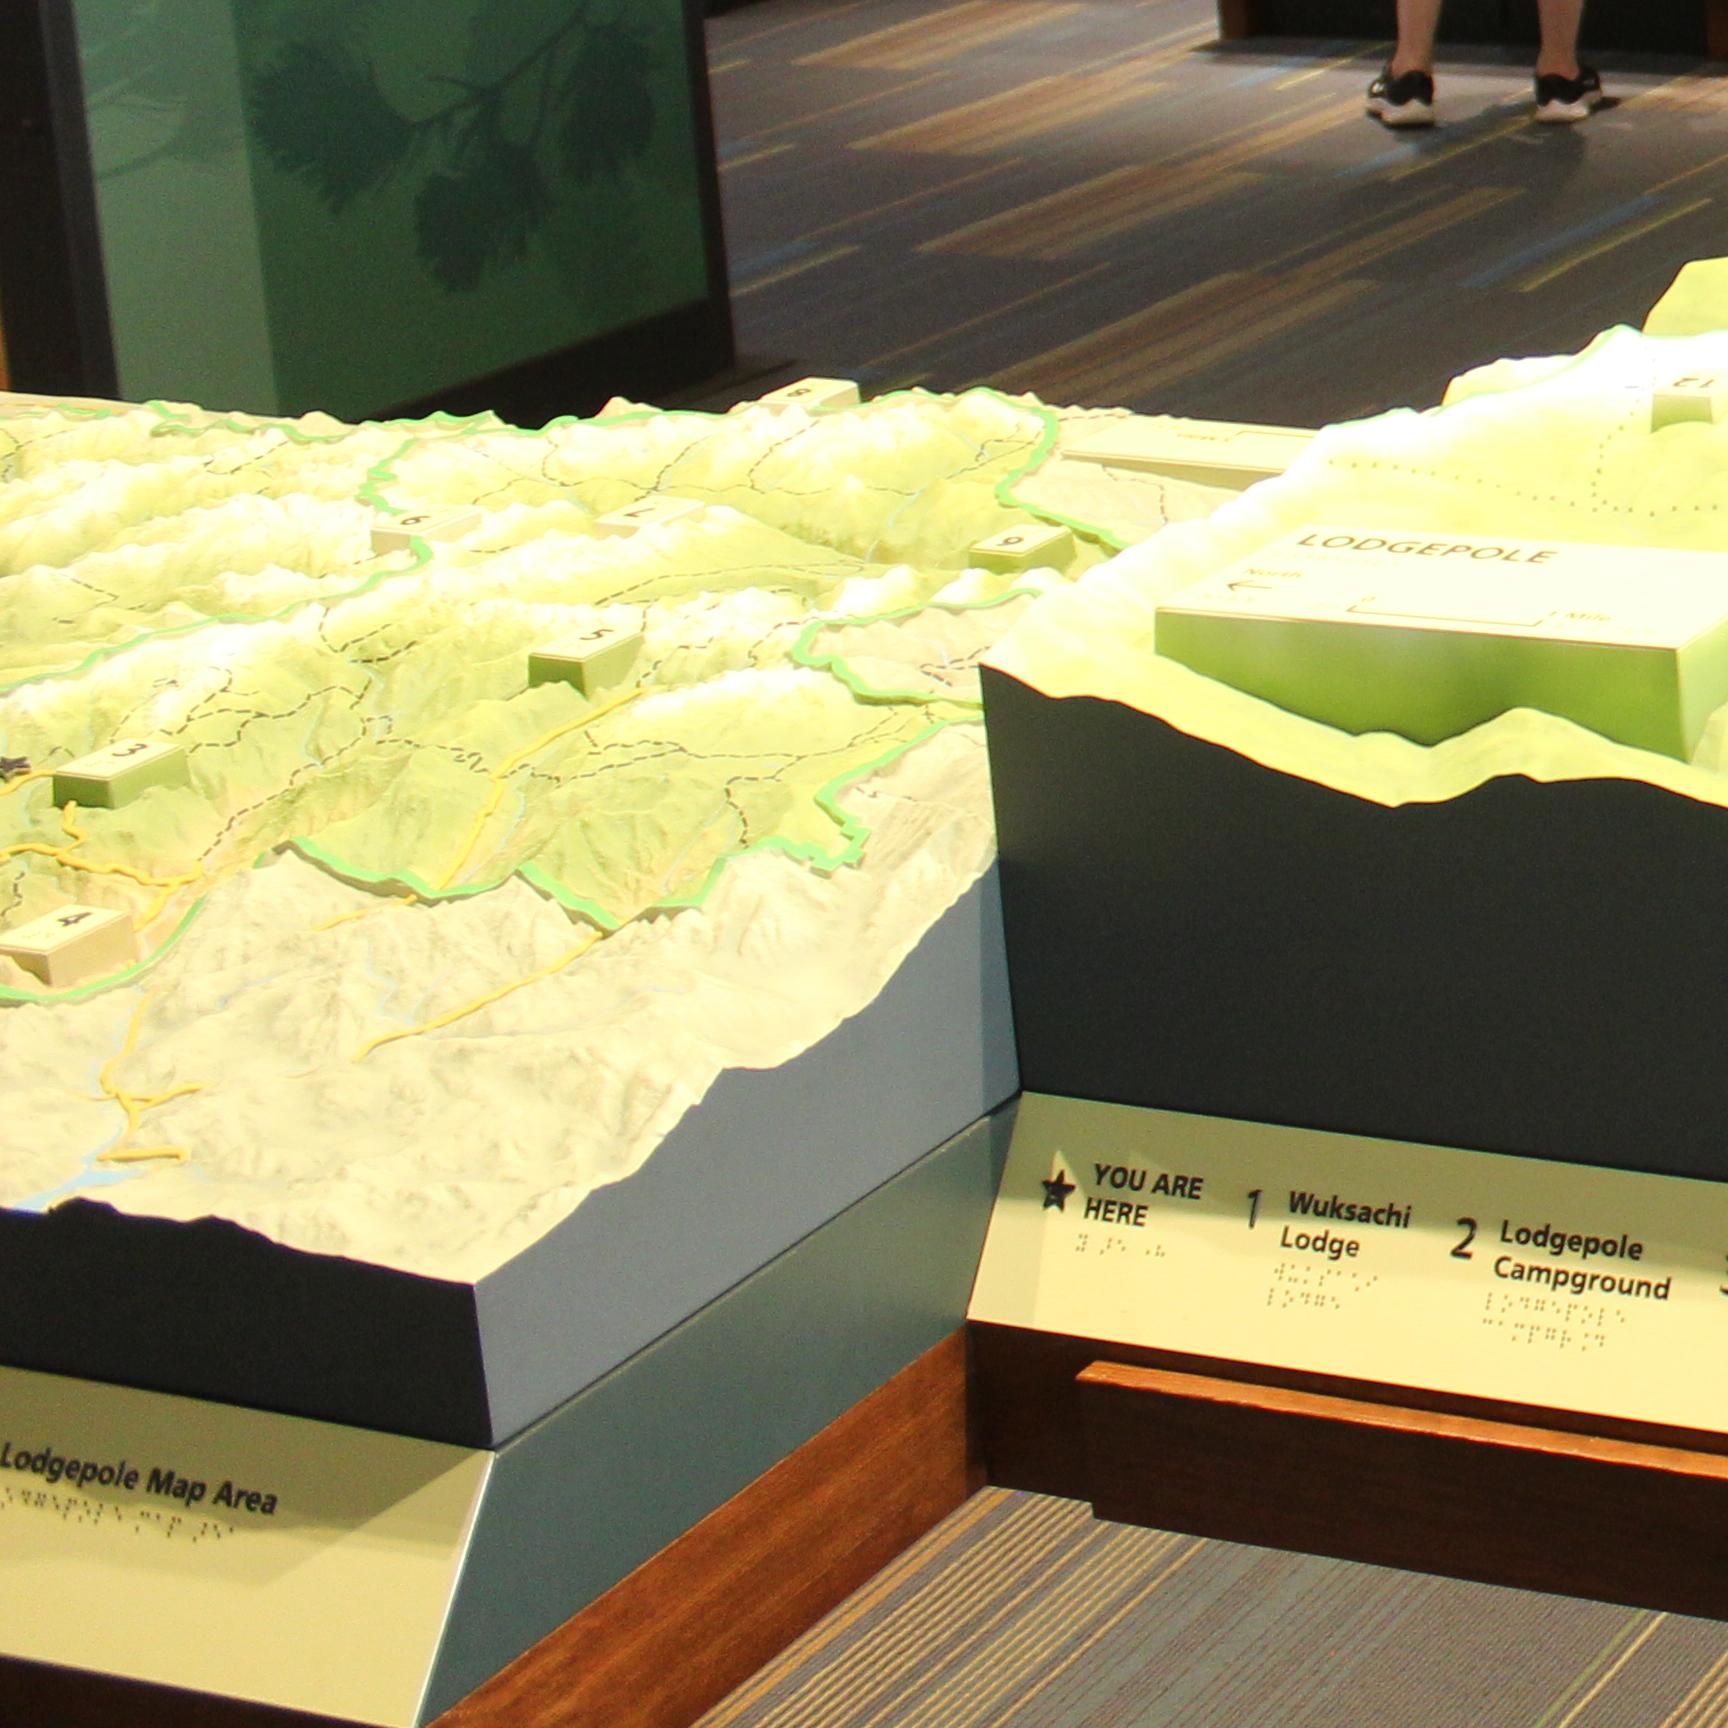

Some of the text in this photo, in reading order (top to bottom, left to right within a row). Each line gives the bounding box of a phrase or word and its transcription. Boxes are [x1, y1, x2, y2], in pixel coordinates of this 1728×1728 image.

[1297, 533, 1560, 565] LODGEPOLE
[1091, 1160, 1205, 1203] YOU ARE
[1084, 1192, 1148, 1229] HERE
[1246, 1188, 1263, 1229] 1
[1288, 1190, 1412, 1231] Wuksachi
[1280, 1226, 1361, 1262] Lodge
[1450, 1217, 1477, 1260] 2
[1500, 1218, 1646, 1266] Lodgepole
[1493, 1256, 1672, 1304] Campground
[0, 1440, 279, 1516] Lodgepole Map Area
